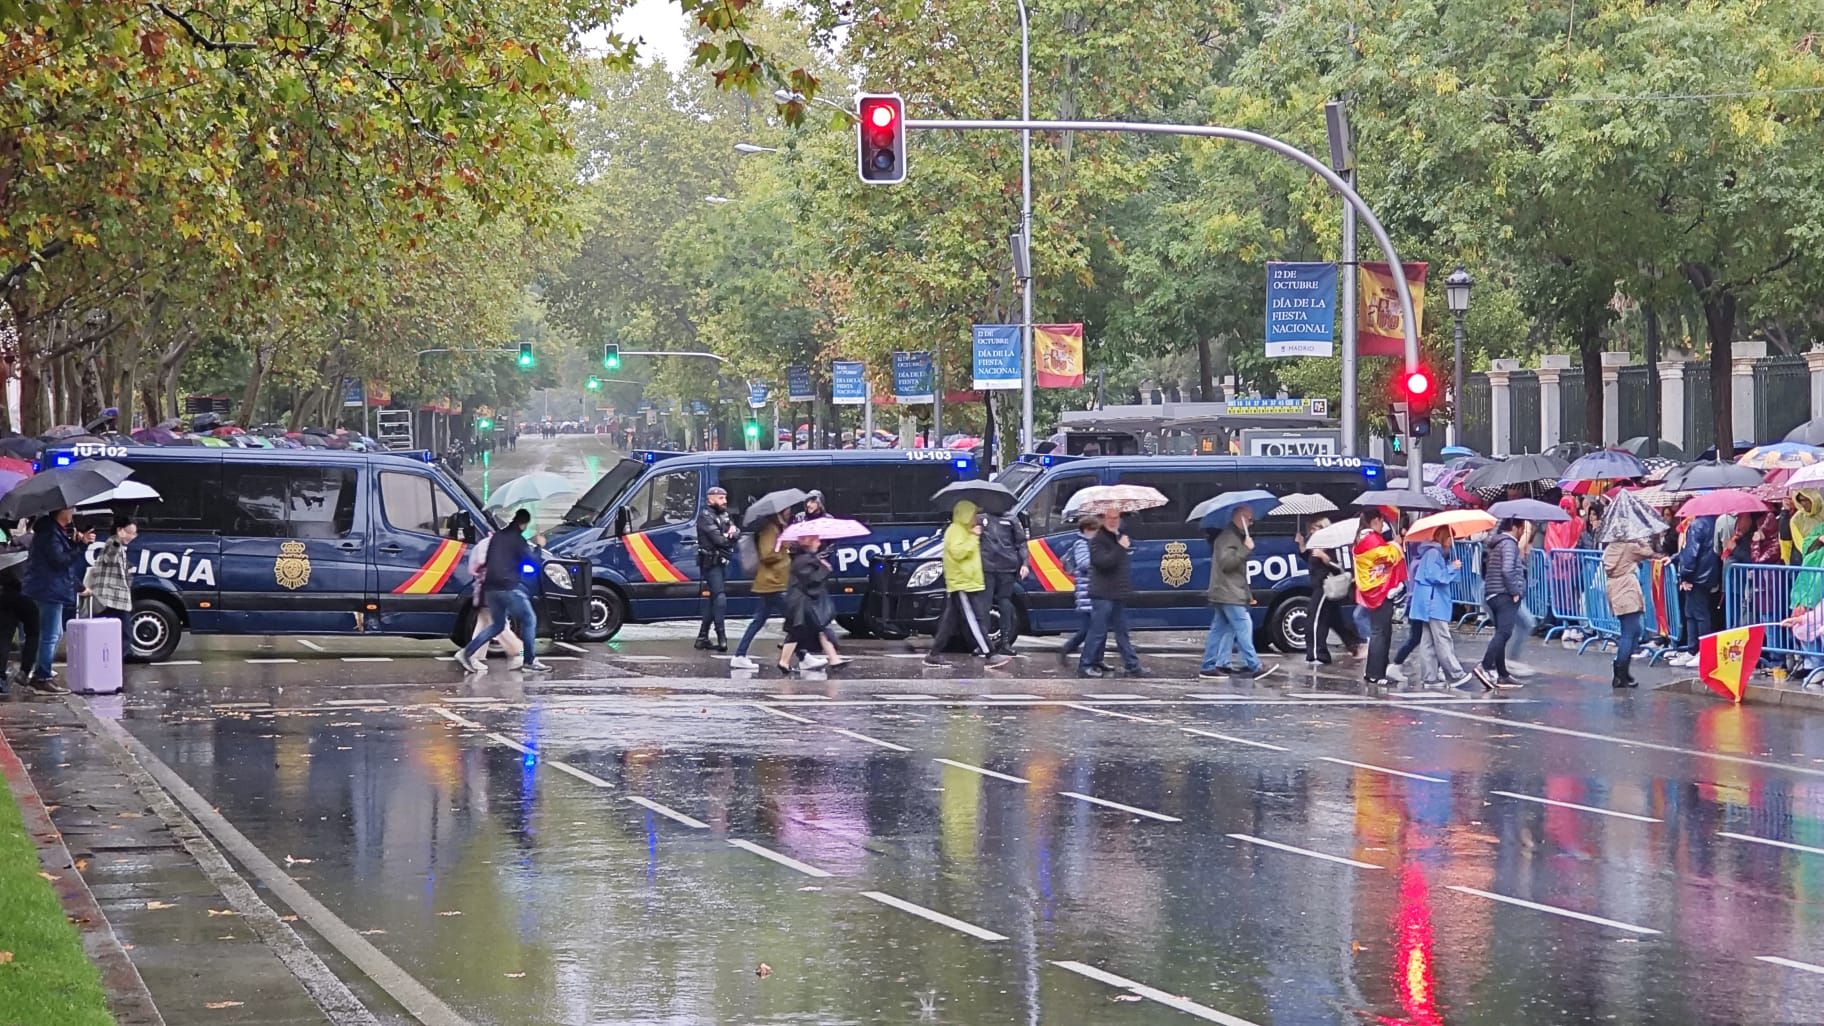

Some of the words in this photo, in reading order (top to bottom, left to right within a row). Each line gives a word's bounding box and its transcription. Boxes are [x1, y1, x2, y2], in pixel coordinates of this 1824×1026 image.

[1274, 270, 1282, 279] 12
[1284, 270, 1297, 279] DE
[1273, 280, 1319, 289] OCTUBRE
[1272, 296, 1291, 308] DÍA
[1294, 298, 1309, 308] DE
[1311, 298, 1326, 308] LA
[1272, 311, 1308, 321] FIESTA
[1272, 323, 1329, 334] NACIONAL
[977, 337, 1009, 345] OCTUBRE
[978, 348, 992, 357] DÍA
[978, 358, 1004, 366] FIESTA
[978, 367, 1018, 375] NACIONAL
[71, 446, 128, 457] 1U-102
[906, 450, 952, 461] 1U-103
[1314, 457, 1361, 467] 1U-100
